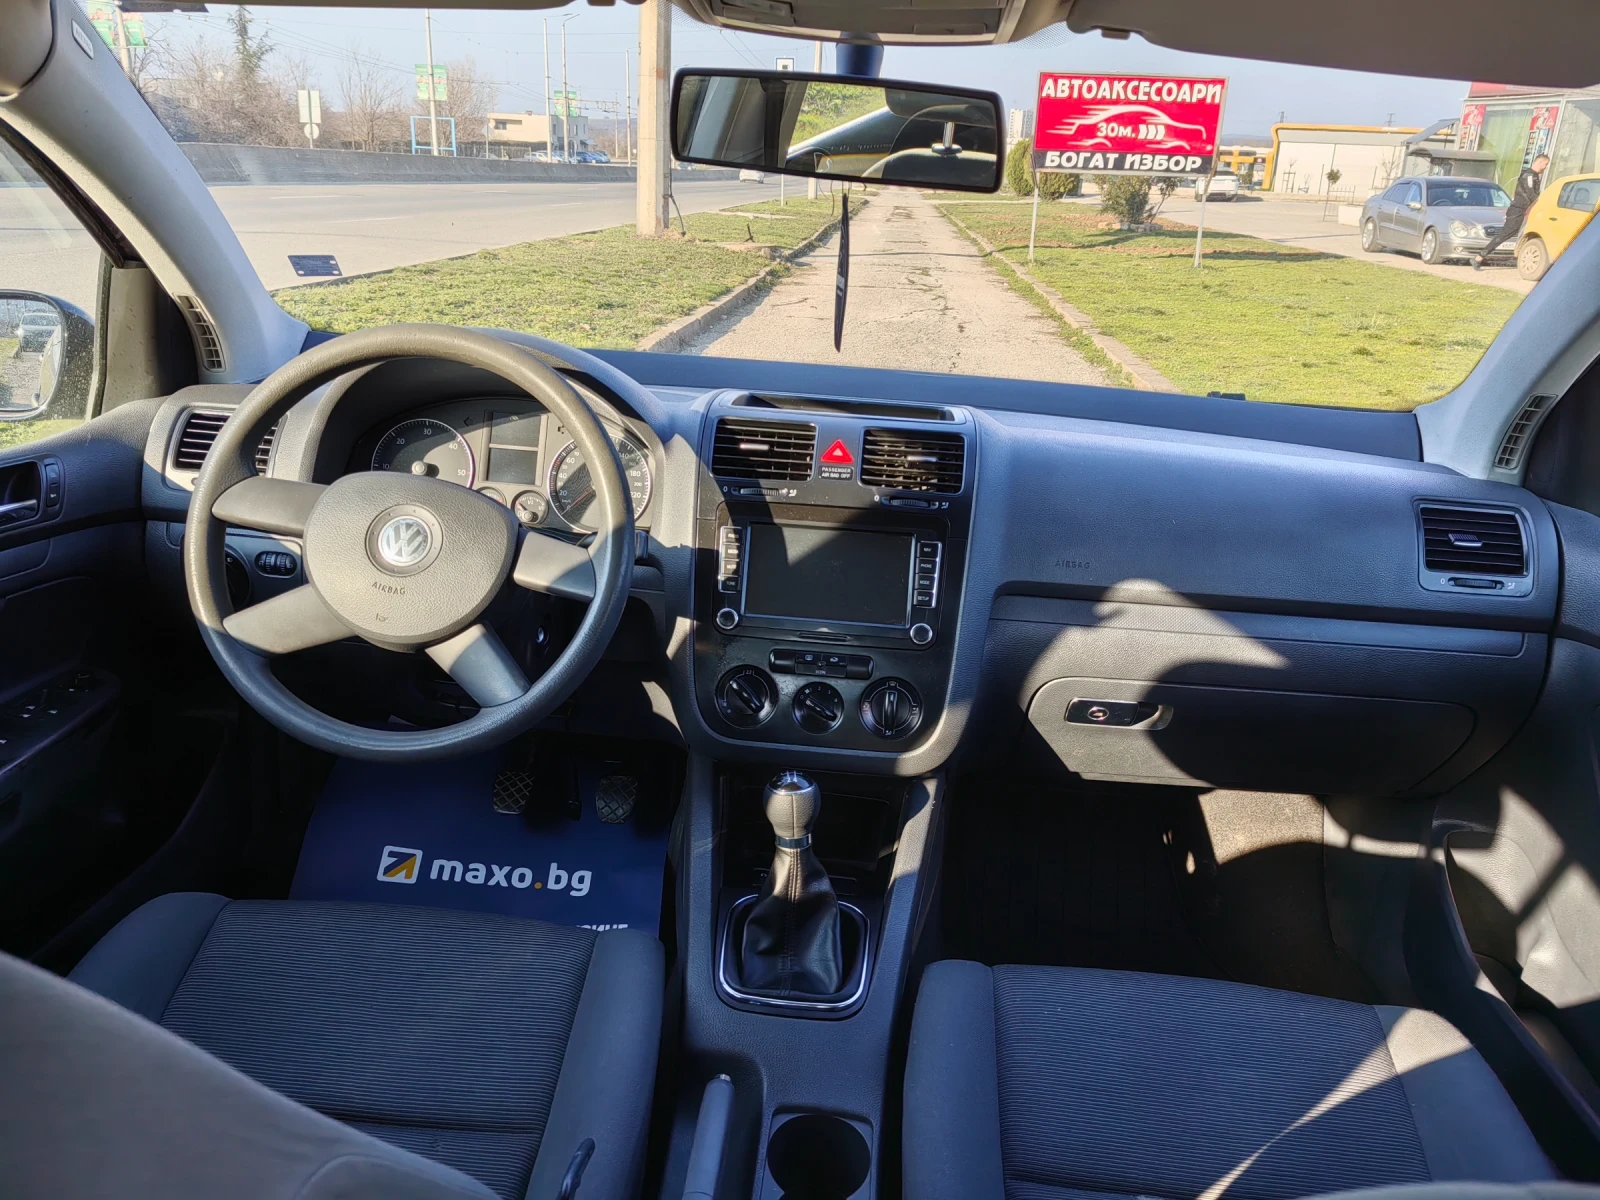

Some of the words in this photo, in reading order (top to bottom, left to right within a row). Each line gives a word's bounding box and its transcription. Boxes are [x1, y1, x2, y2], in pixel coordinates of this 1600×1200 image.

[1041, 78, 1222, 104] АВТОАКСЕСОАРИ
[1045, 151, 1119, 169] БОГАТ
[1123, 154, 1202, 171] ИЗБОР
[1055, 560, 1091, 569] AIRBAG
[371, 581, 406, 595] AIRBAG
[429, 858, 592, 897] maxo.bg
